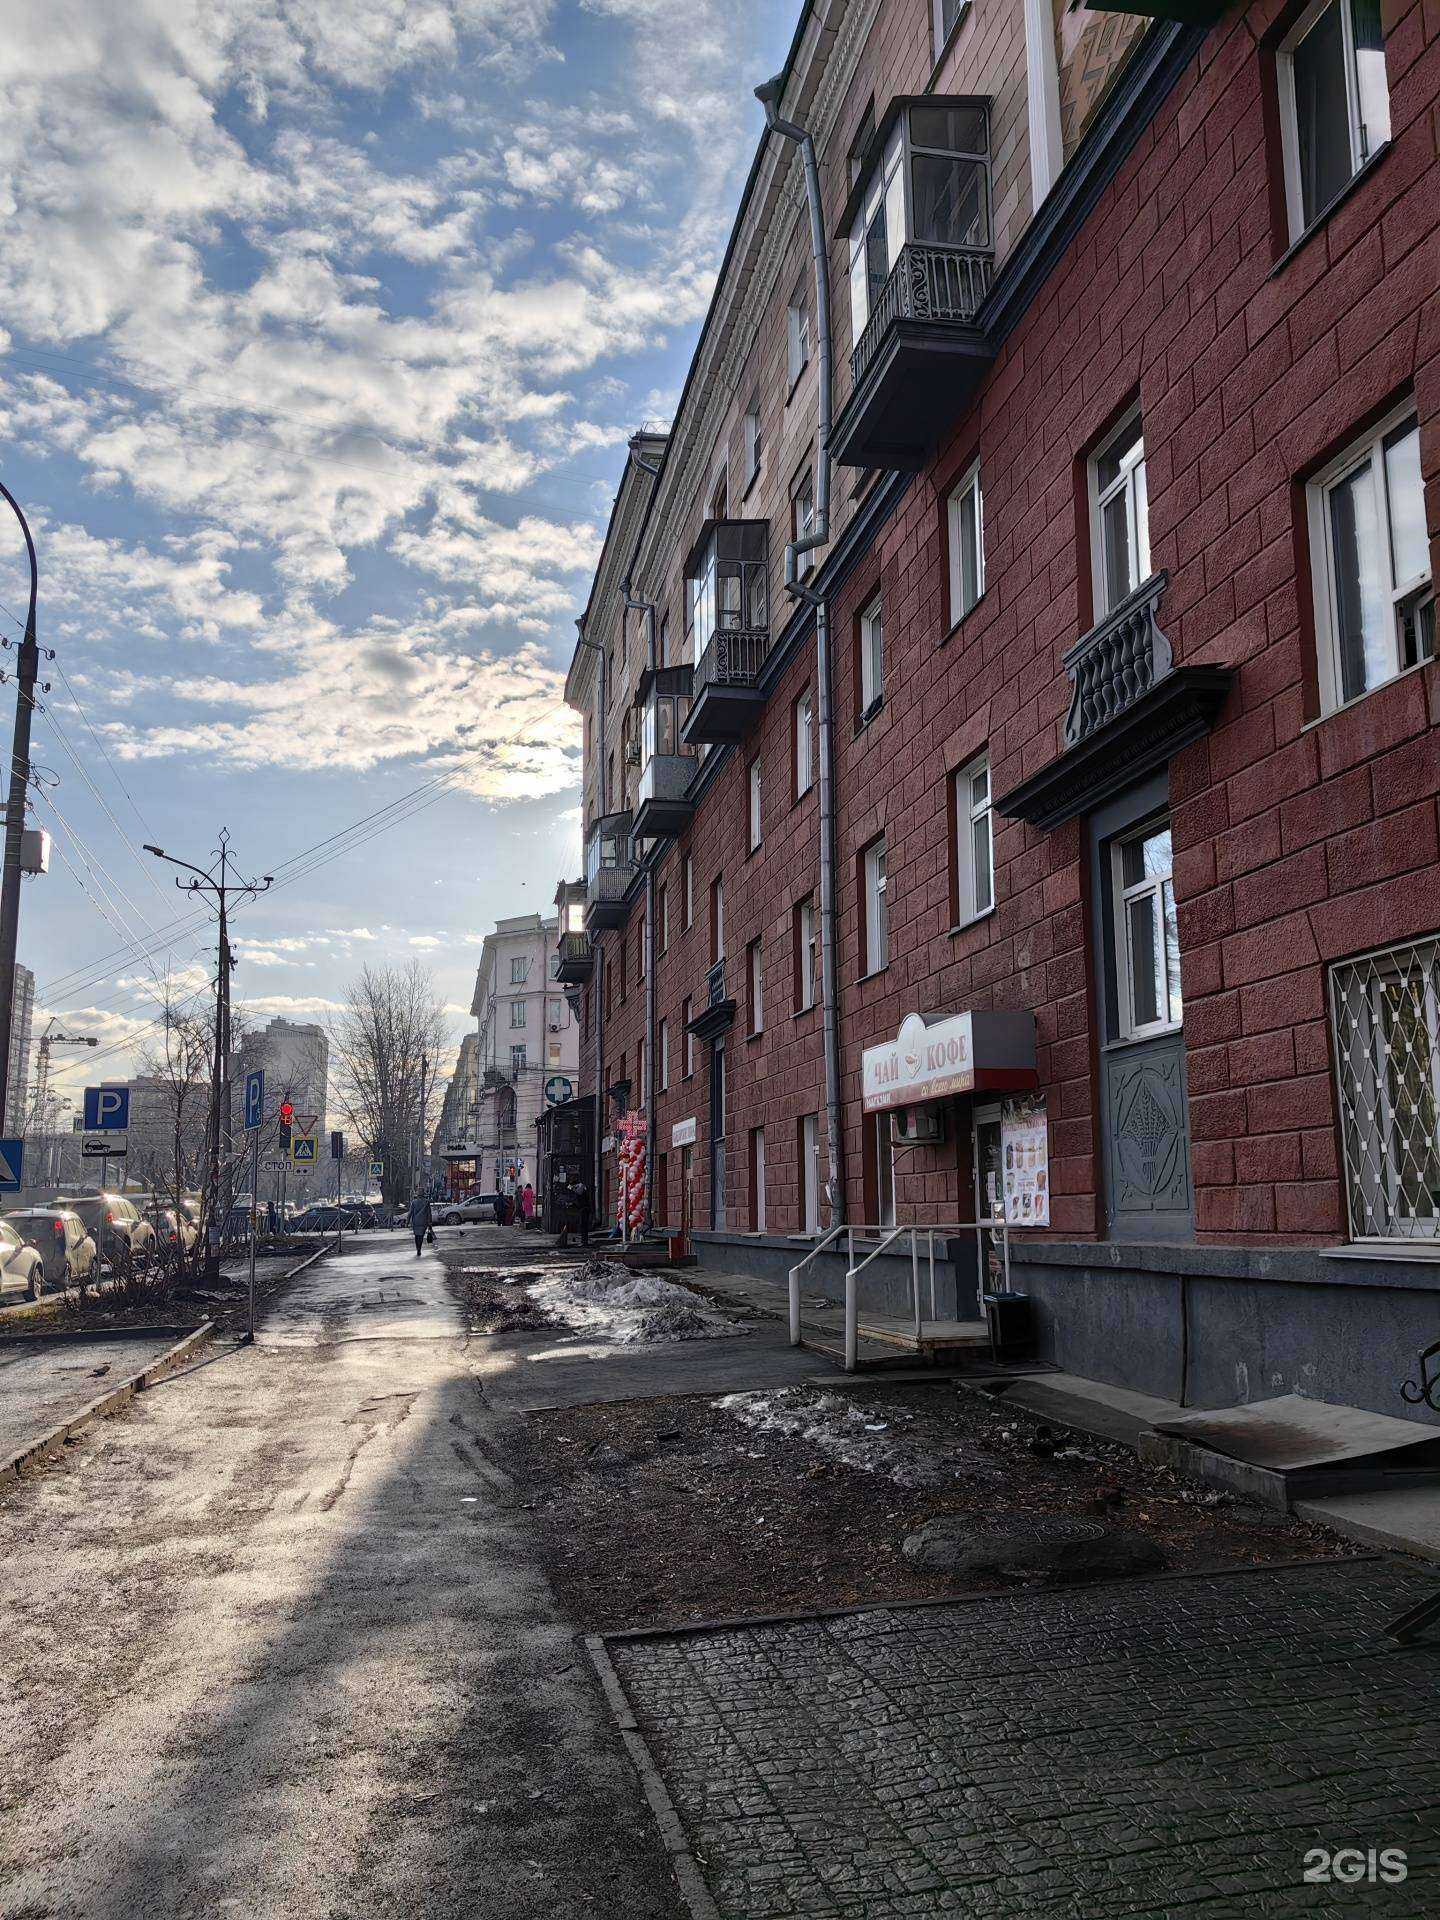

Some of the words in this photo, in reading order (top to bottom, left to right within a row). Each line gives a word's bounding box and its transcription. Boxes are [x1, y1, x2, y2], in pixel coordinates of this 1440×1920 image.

[874, 1051, 899, 1084] ЧАЙ
[926, 1035, 967, 1072] КОФЕ
[264, 1161, 292, 1171] СТОП
